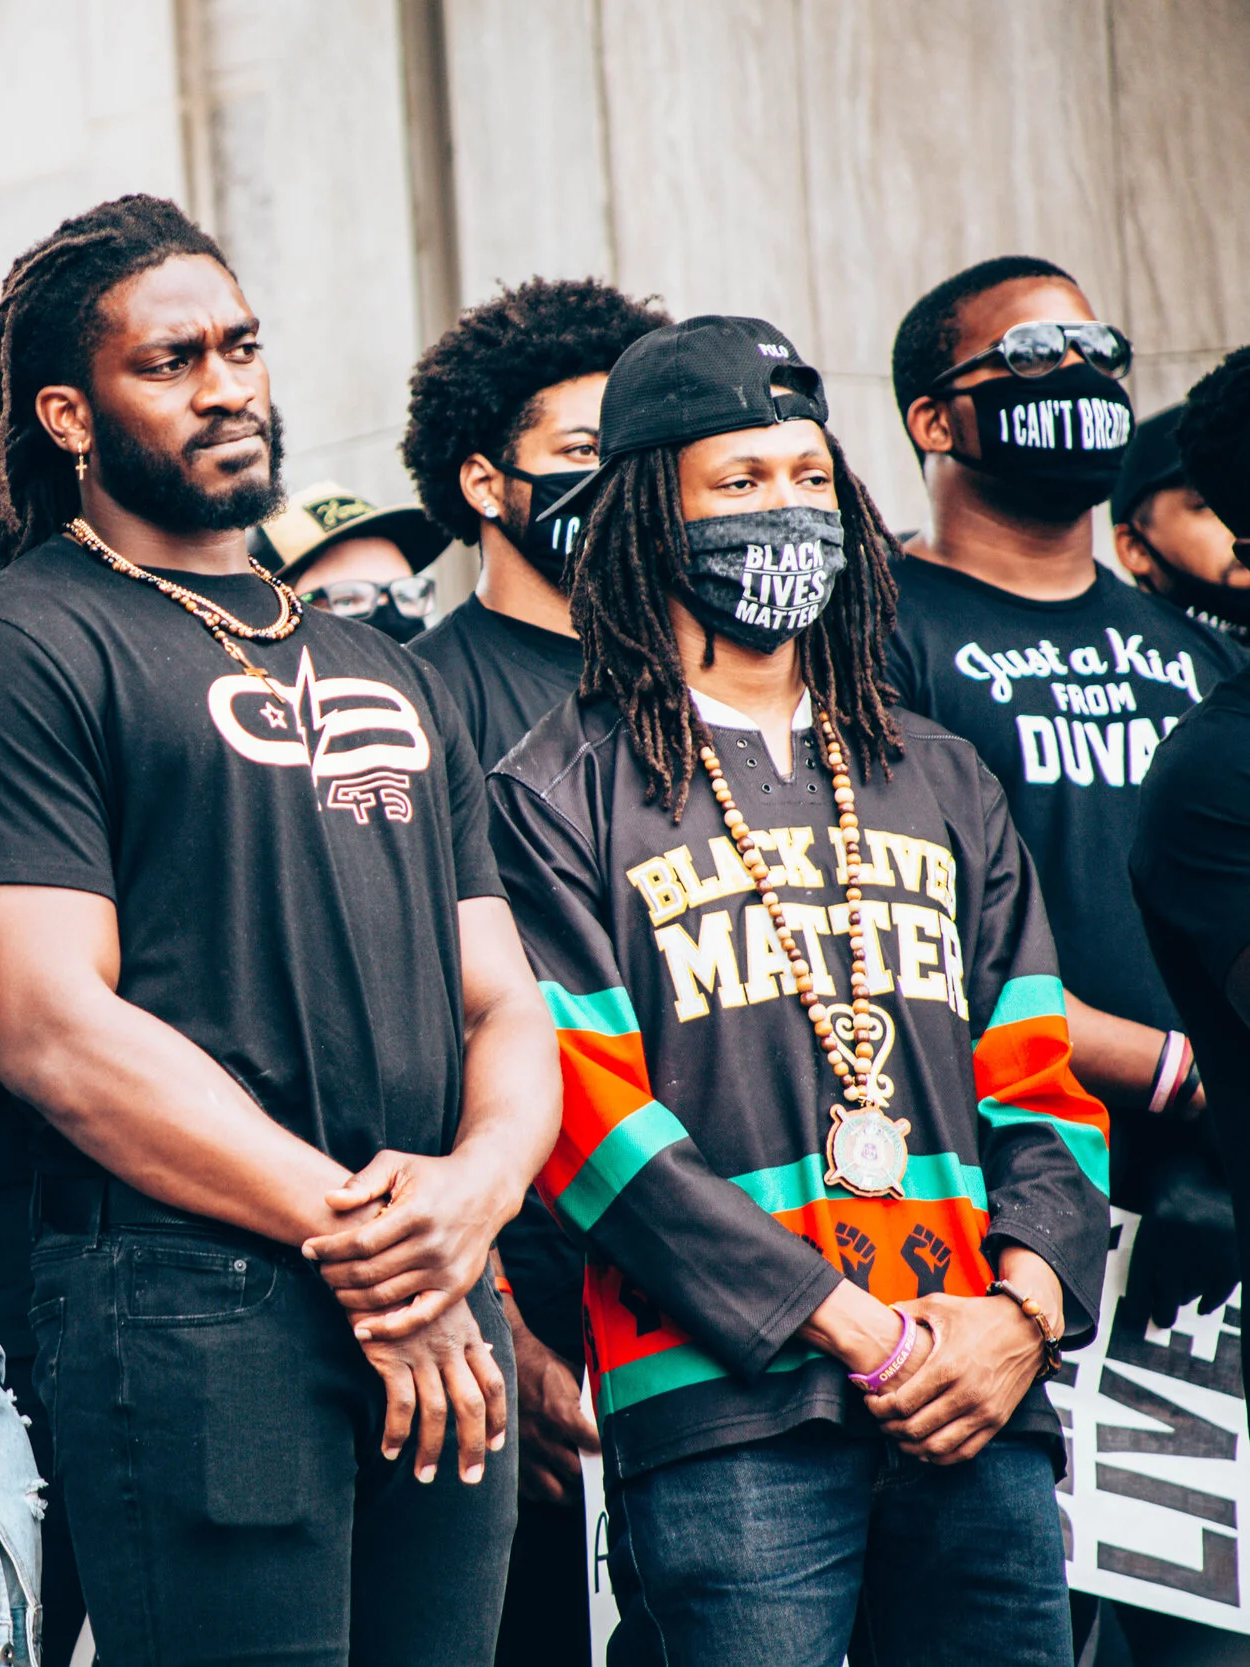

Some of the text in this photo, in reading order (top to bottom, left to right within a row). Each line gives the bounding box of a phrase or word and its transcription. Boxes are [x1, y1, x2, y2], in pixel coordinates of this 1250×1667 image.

[999, 408, 1009, 443] I
[1012, 399, 1073, 450] CAN'T
[745, 539, 824, 572] BLACK
[742, 570, 827, 607] LIVES
[734, 599, 819, 630] MATTER
[954, 627, 1203, 704] Just a Kid
[1051, 681, 1137, 716] FROM
[1015, 714, 1180, 788] DUVA
[625, 826, 957, 927] BLACK LIVES
[653, 899, 970, 1023] MATTER
[878, 1349, 910, 1382] OMEGA
[1096, 1223, 1241, 1608] LIVE
